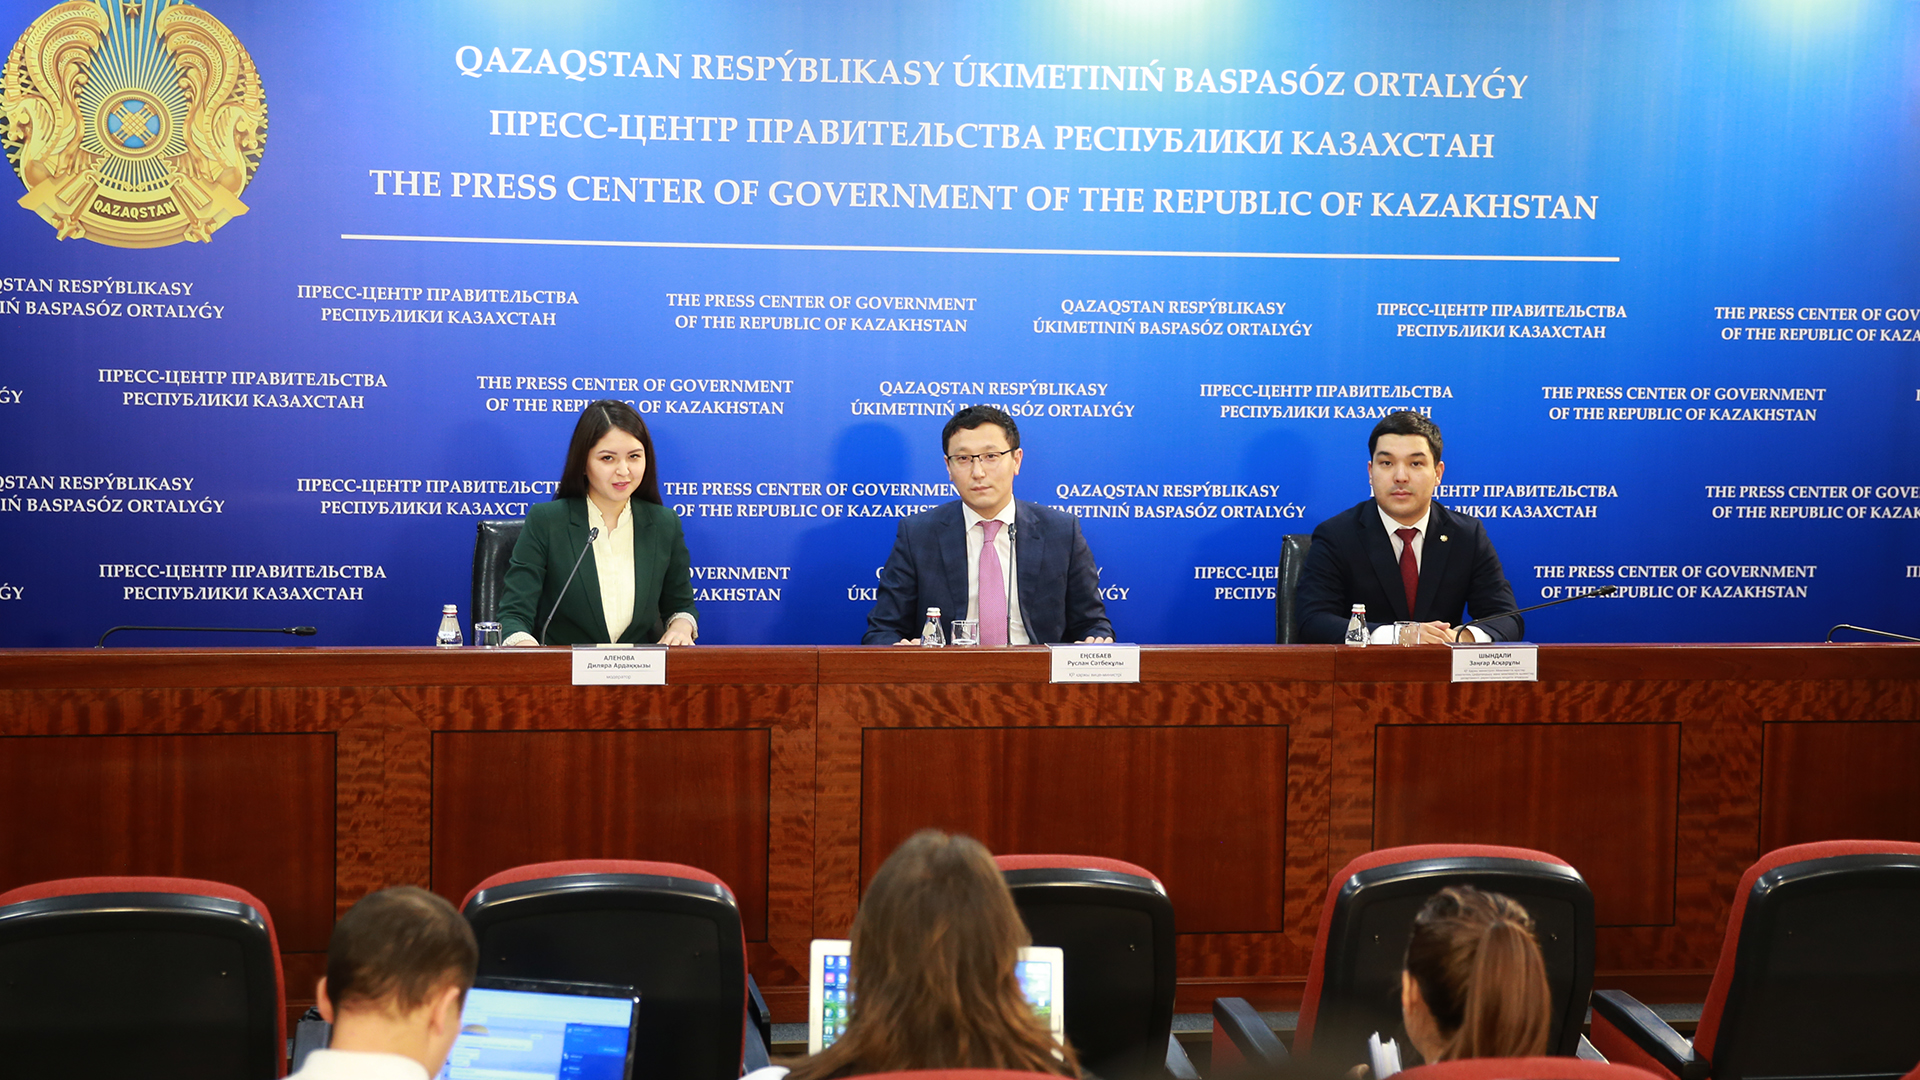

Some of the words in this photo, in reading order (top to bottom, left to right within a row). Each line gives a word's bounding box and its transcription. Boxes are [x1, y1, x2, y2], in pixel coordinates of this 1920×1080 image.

[455, 45, 683, 83] QAZAQSTAN
[690, 49, 945, 86] RESPÝBLIKASY
[952, 54, 1166, 92] ÚKIMETINIŃ
[1174, 63, 1346, 96] BASPASÓZ
[489, 109, 739, 147] ПРЕСС-ЦЕНТР
[746, 117, 1046, 150] ПРАВИТЕЛЬСТВА
[1053, 125, 1284, 155] РЕСПУБЛИКИ
[1290, 130, 1496, 159] КАЗАХСТАН
[368, 169, 442, 197] THE
[450, 171, 558, 201] PRESS
[566, 175, 706, 204] CENTER
[713, 179, 760, 206] OF
[768, 180, 1019, 211] GOVERNMENT
[1026, 185, 1071, 212] OF
[1077, 186, 1145, 213] THE
[1152, 188, 1313, 217] REPUBLIC
[1319, 191, 1364, 217] OF
[1370, 191, 1600, 221] KAZAKHSTAN
[93, 200, 176, 220] QAZAQSTAN
[57, 276, 194, 296] RESPÝBLIKASY
[297, 284, 424, 304] ПРЕСС-ЦЕНТР
[426, 287, 580, 305] ПРАВИТЕЛЬСТВА
[24, 298, 123, 317] BASPASÓZ
[665, 293, 701, 307] THE
[704, 293, 756, 309] PRESS
[758, 294, 826, 309] CENTER
[828, 295, 852, 310] OF
[855, 295, 978, 311] GOVERNMENT
[1060, 298, 1166, 316] QAZAQSTAN
[1167, 297, 1287, 316] RESPÝBLIKASY
[1376, 302, 1489, 320] ПРЕСС-ЦЕНТР
[1490, 303, 1628, 319] ПРАВИТЕЛЬСТВА
[320, 307, 444, 324] РЕСПУБЛИКИ
[447, 310, 557, 326] КАЗАХСТАН
[1713, 306, 1746, 320] THE
[1747, 306, 1795, 321] PRESS
[1797, 307, 1859, 321] CENTER
[1860, 307, 1883, 322] OF
[674, 314, 698, 329] OF
[700, 315, 736, 330] THE
[738, 315, 822, 331] REPUBLIC
[824, 316, 848, 331] OF
[850, 317, 968, 333] KAZAKHSTAN
[1032, 316, 1137, 335] ÚKIMETINIŃ
[1138, 318, 1224, 336] BASPASÓZ
[1396, 323, 1506, 338] РЕСПУБЛИКИ
[1507, 324, 1607, 339] КАЗАХСТАН
[1720, 326, 1743, 341] OF
[1744, 327, 1777, 341] THE
[1778, 327, 1854, 342] REPUBLIC
[1855, 328, 1878, 342] OF
[98, 368, 228, 387] ПРЕСС-ЦЕНТР
[230, 370, 388, 388] ПРАВИТЕЛЬСТВА
[476, 375, 513, 390] THE
[515, 376, 568, 391] PRESS
[571, 376, 640, 392] CENTER
[642, 378, 667, 392] OF
[669, 378, 795, 394] GOVERNMENT
[879, 380, 985, 398] QAZAQSTAN
[987, 378, 1109, 397] RESPÝBLIKASY
[1199, 383, 1313, 401] ПРЕСС-ЦЕНТР
[1314, 384, 1454, 399] ПРАВИТЕЛЬСТВА
[1541, 386, 1574, 400] THE
[1575, 386, 1624, 401] PRESS
[1625, 386, 1688, 401] CENTER
[1689, 386, 1712, 401] OF
[1713, 387, 1827, 402] GOVERNMENT
[122, 391, 249, 408] РЕСПУБЛИКИ
[252, 393, 365, 409] КАЗАХСТАН
[485, 397, 510, 412] OF
[512, 397, 548, 412] THE
[638, 399, 662, 414] OF
[664, 400, 785, 415] KAZAKHSTAN
[850, 398, 956, 417] ÚKIMETINIŃ
[1219, 404, 1331, 420] РЕСПУБЛИКИ
[1548, 406, 1571, 421] OF
[1572, 406, 1605, 421] THE
[1606, 406, 1683, 421] REPUBLIC
[1684, 407, 1707, 421] OF
[1708, 407, 1818, 422] KAZAKHSTAN
[58, 472, 194, 492] RESPÝBLIKASY
[296, 478, 423, 496] ПРЕСС-ЦЕНТР
[663, 481, 699, 496] THE
[701, 482, 753, 497] PRESS
[755, 482, 823, 497] CENTER
[825, 482, 849, 497] OF
[851, 482, 961, 497] GOVERNMEN
[1055, 483, 1160, 501] QAZAQSTAN
[1162, 480, 1281, 498] RESPÝBLIKASY
[1482, 484, 1619, 499] ПРАВИТЕЛЬСТВА
[1704, 485, 1737, 499] THE
[1738, 485, 1786, 499] PRESS
[1787, 485, 1849, 499] CENTER
[1851, 485, 1873, 499] OF
[26, 494, 124, 513] BASPASÓZ
[320, 500, 445, 516] РЕСПУБЛИКИ
[672, 503, 696, 518] OF
[698, 503, 734, 518] THE
[736, 503, 819, 518] REPUBLIC
[820, 503, 844, 518] OF
[1133, 501, 1218, 519] BASPASÓZ
[1500, 504, 1598, 519] КАЗАХСТАН
[1711, 505, 1734, 519] OF
[1735, 505, 1767, 519] THE
[1769, 505, 1844, 519] REPUBLIC
[1846, 505, 1868, 520] OF
[98, 564, 228, 582] ПРЕСС-ЦЕНТР
[230, 564, 388, 579] ПРАВИТЕЛЬСТВА
[1533, 565, 1566, 579] THE
[1567, 565, 1615, 579] PRESS
[1617, 564, 1679, 579] CENTER
[1681, 565, 1703, 579] OF
[1705, 564, 1818, 579] GOVERNMENT
[123, 586, 249, 601] РЕСПУБЛИКИ
[252, 586, 364, 601] КАЗАХСТАН
[1214, 586, 1277, 600] РЕСПУБ
[1540, 585, 1563, 599] OF
[1564, 585, 1597, 599] THE
[1676, 585, 1698, 599] OF
[1699, 585, 1808, 599] KAZAKHSTAN
